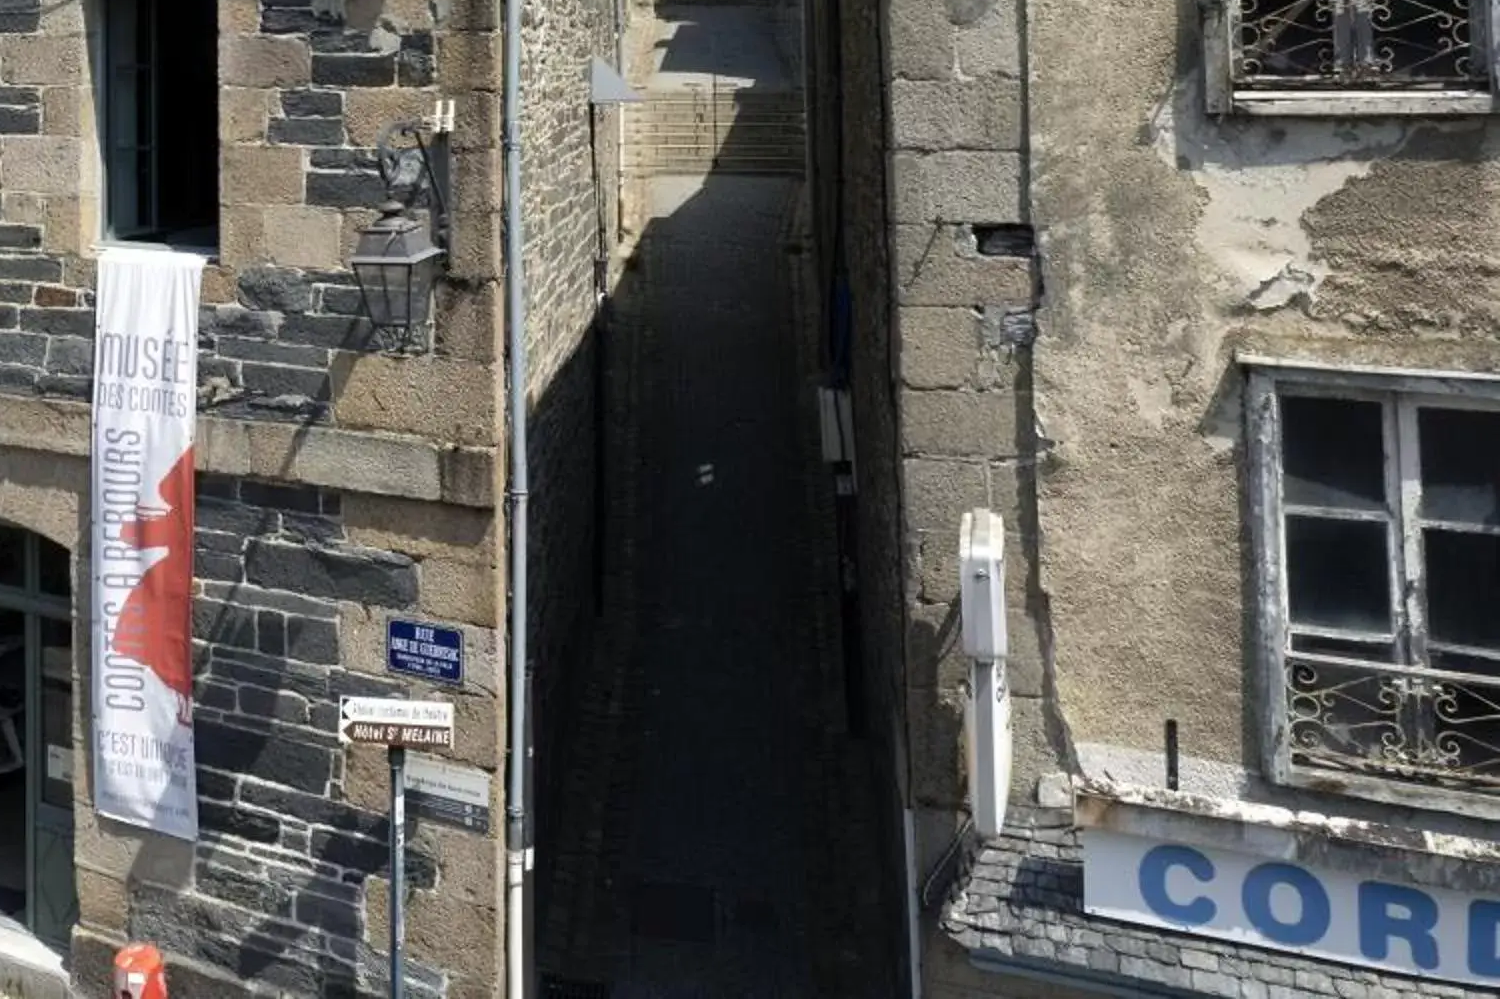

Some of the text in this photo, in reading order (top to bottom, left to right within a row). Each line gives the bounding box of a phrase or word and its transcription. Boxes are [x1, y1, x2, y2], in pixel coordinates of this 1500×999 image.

[100, 329, 189, 384] MUSÉE
[98, 382, 188, 418] DES CONTES
[103, 428, 142, 561] REBOURS
